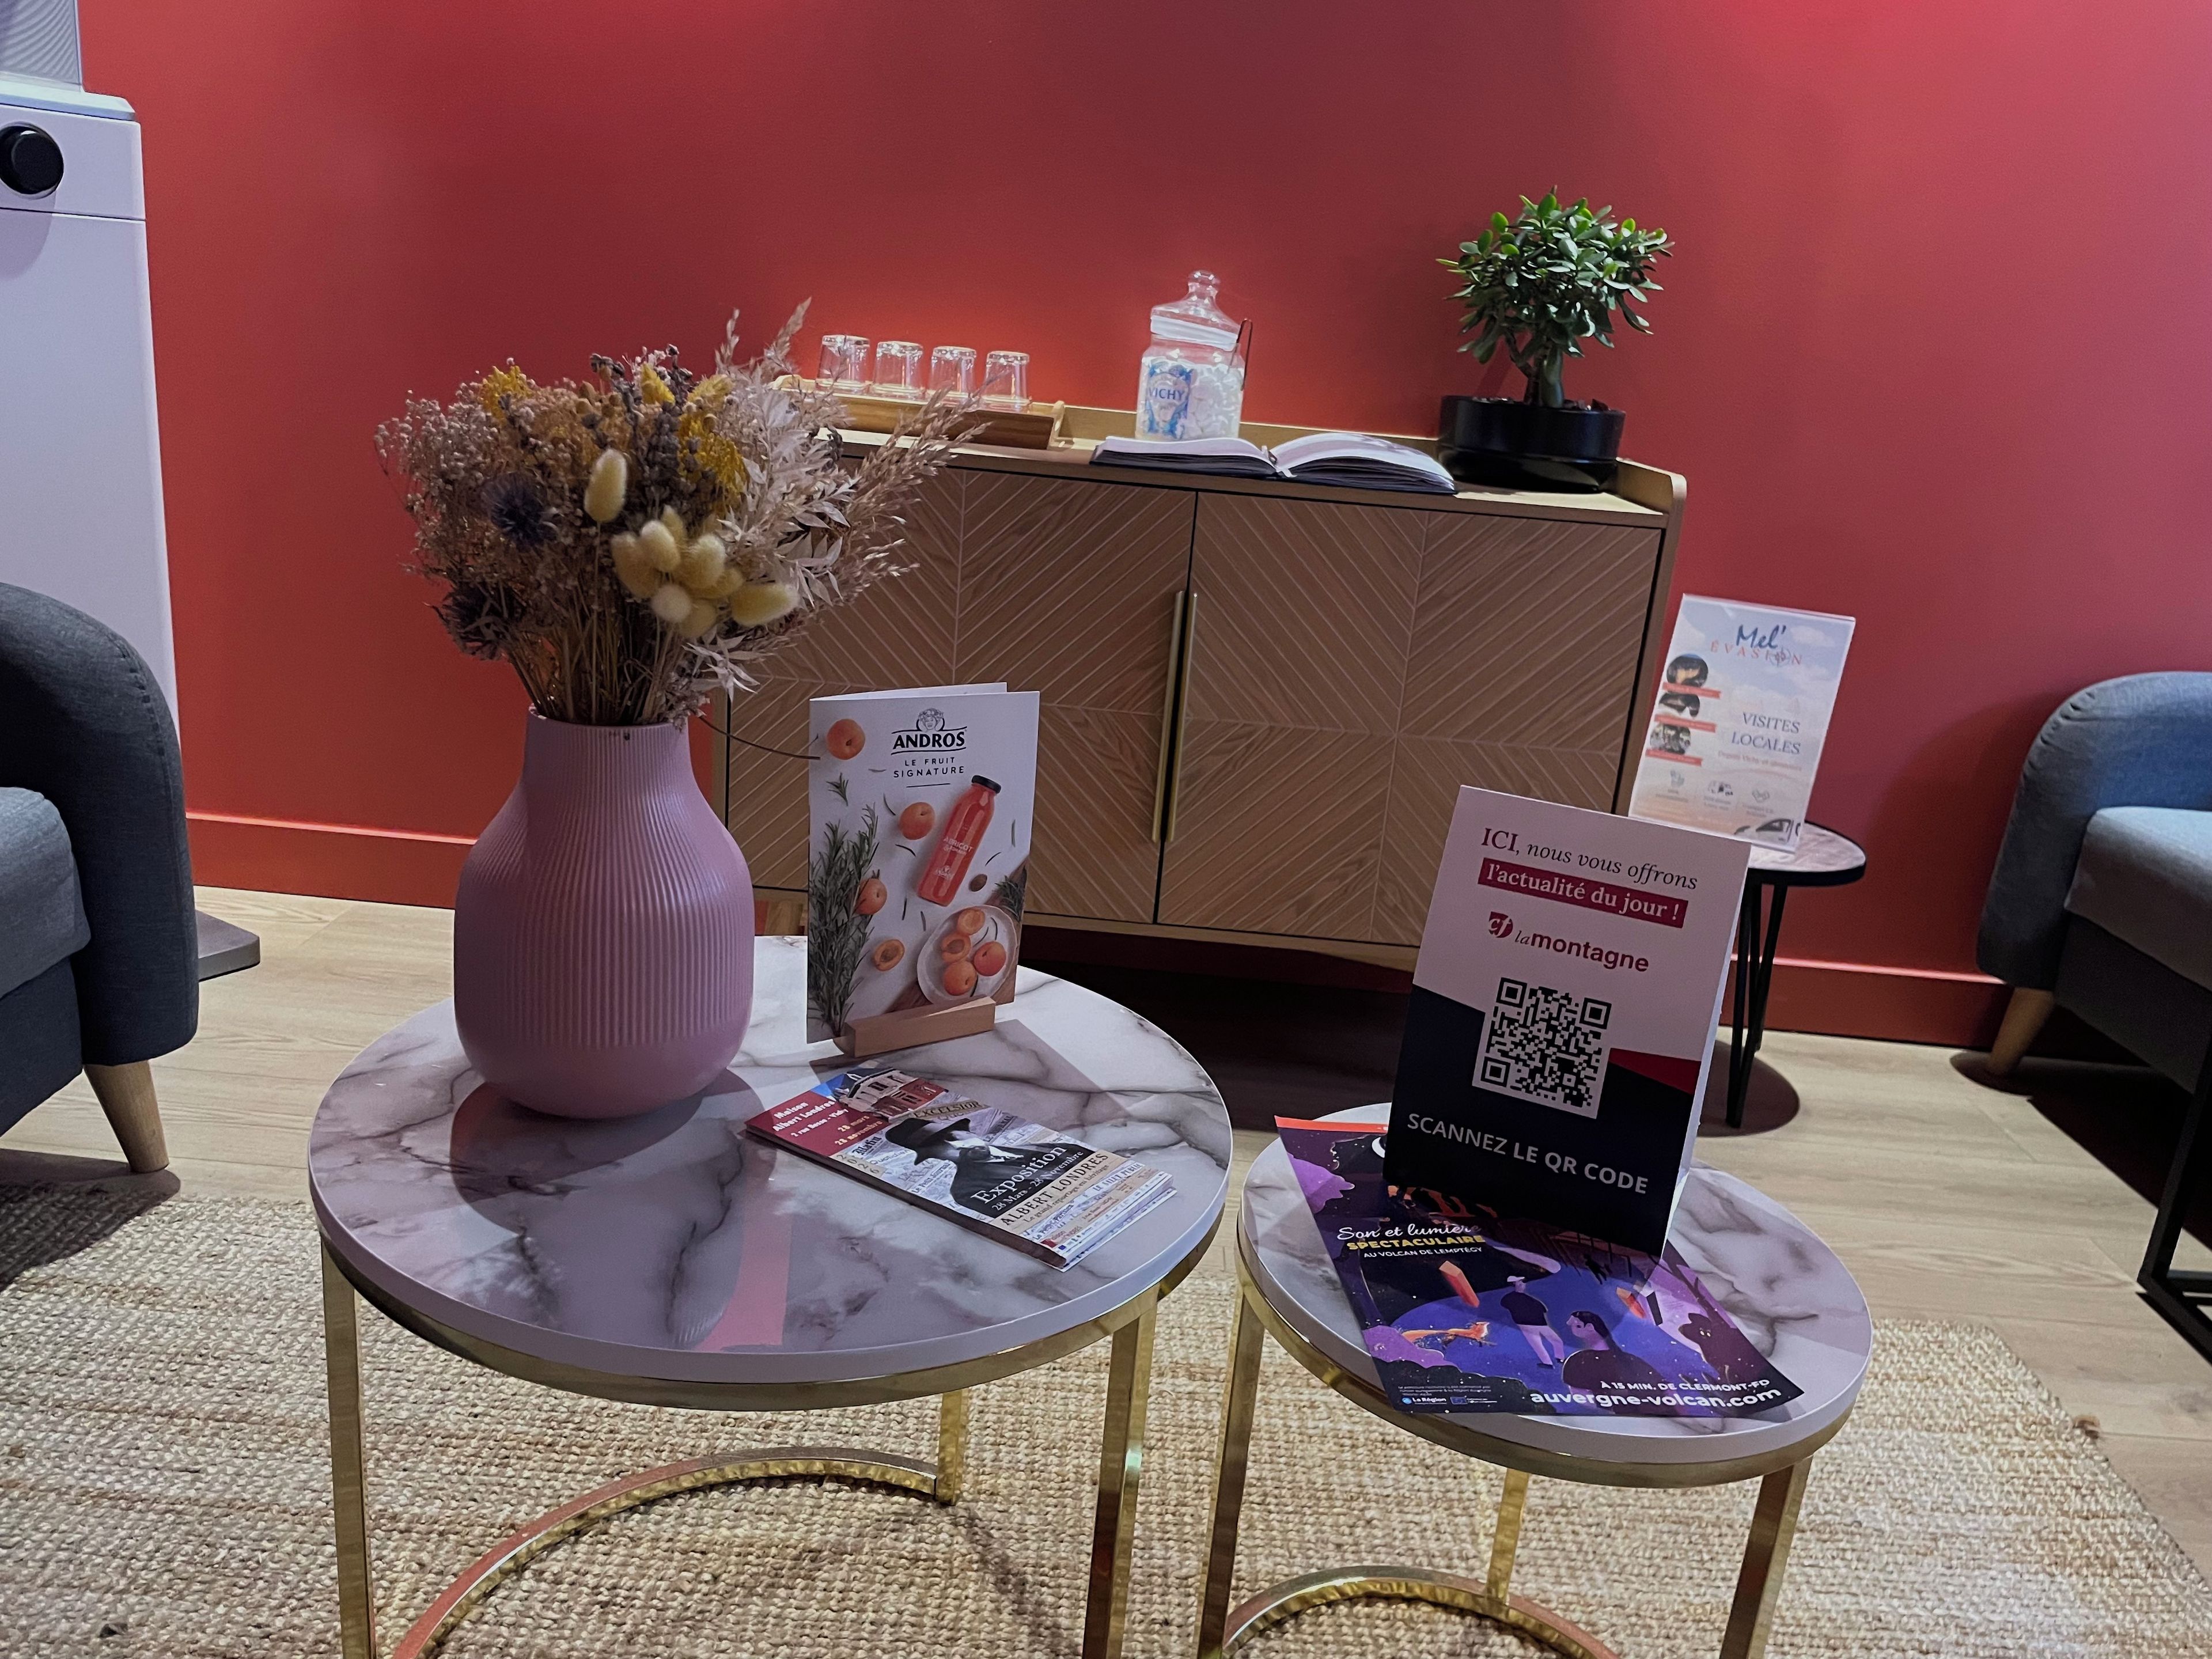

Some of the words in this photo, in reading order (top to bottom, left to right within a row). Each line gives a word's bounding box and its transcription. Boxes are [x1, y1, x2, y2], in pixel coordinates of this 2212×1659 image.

[1743, 711, 1801, 734] VISITES
[893, 732, 965, 749] ANDROS
[1731, 732, 1801, 755] LOCALES
[925, 757, 955, 765] FRUIT
[893, 766, 964, 778] SIGNATURE
[1481, 828, 1520, 855] ICI,
[1527, 844, 1572, 863] nous
[1578, 854, 1622, 873] vous
[1628, 863, 1698, 889] offrons
[1486, 864, 1585, 900] l'actualité
[1591, 887, 1617, 907] du
[1619, 893, 1668, 918] jour
[772, 1116, 802, 1131] Albert
[799, 1100, 836, 1119] Londres
[774, 1102, 809, 1119] Maison
[914, 1100, 982, 1118] EXCELSIOR
[838, 1124, 850, 1132] 28
[850, 1115, 870, 1126] mars
[847, 1121, 883, 1140] novembre
[1407, 1113, 1508, 1155] SCANNEZ
[1513, 1142, 1539, 1164] LE
[1545, 1152, 1577, 1175] QR
[1584, 1163, 1649, 1194] CODE
[970, 1146, 1067, 1204] Exposition
[991, 1202, 1007, 1211] 28
[1002, 1190, 1028, 1205] Mars
[1029, 1177, 1044, 1187] 28
[1040, 1151, 1084, 1180] Novembre
[1001, 1191, 1053, 1225] ALBERT
[1051, 1153, 1108, 1192] LONDRES
[1034, 1204, 1053, 1218] grand
[1052, 1184, 1080, 1208] reportage
[1336, 1226, 1381, 1240] Son
[1385, 1227, 1403, 1237] et
[1347, 1235, 1486, 1250] SPECTACULAIRE
[1680, 1379, 1770, 1392] CLERMONT-FD
[1530, 1388, 1782, 1407] auvergne-volcan.com
